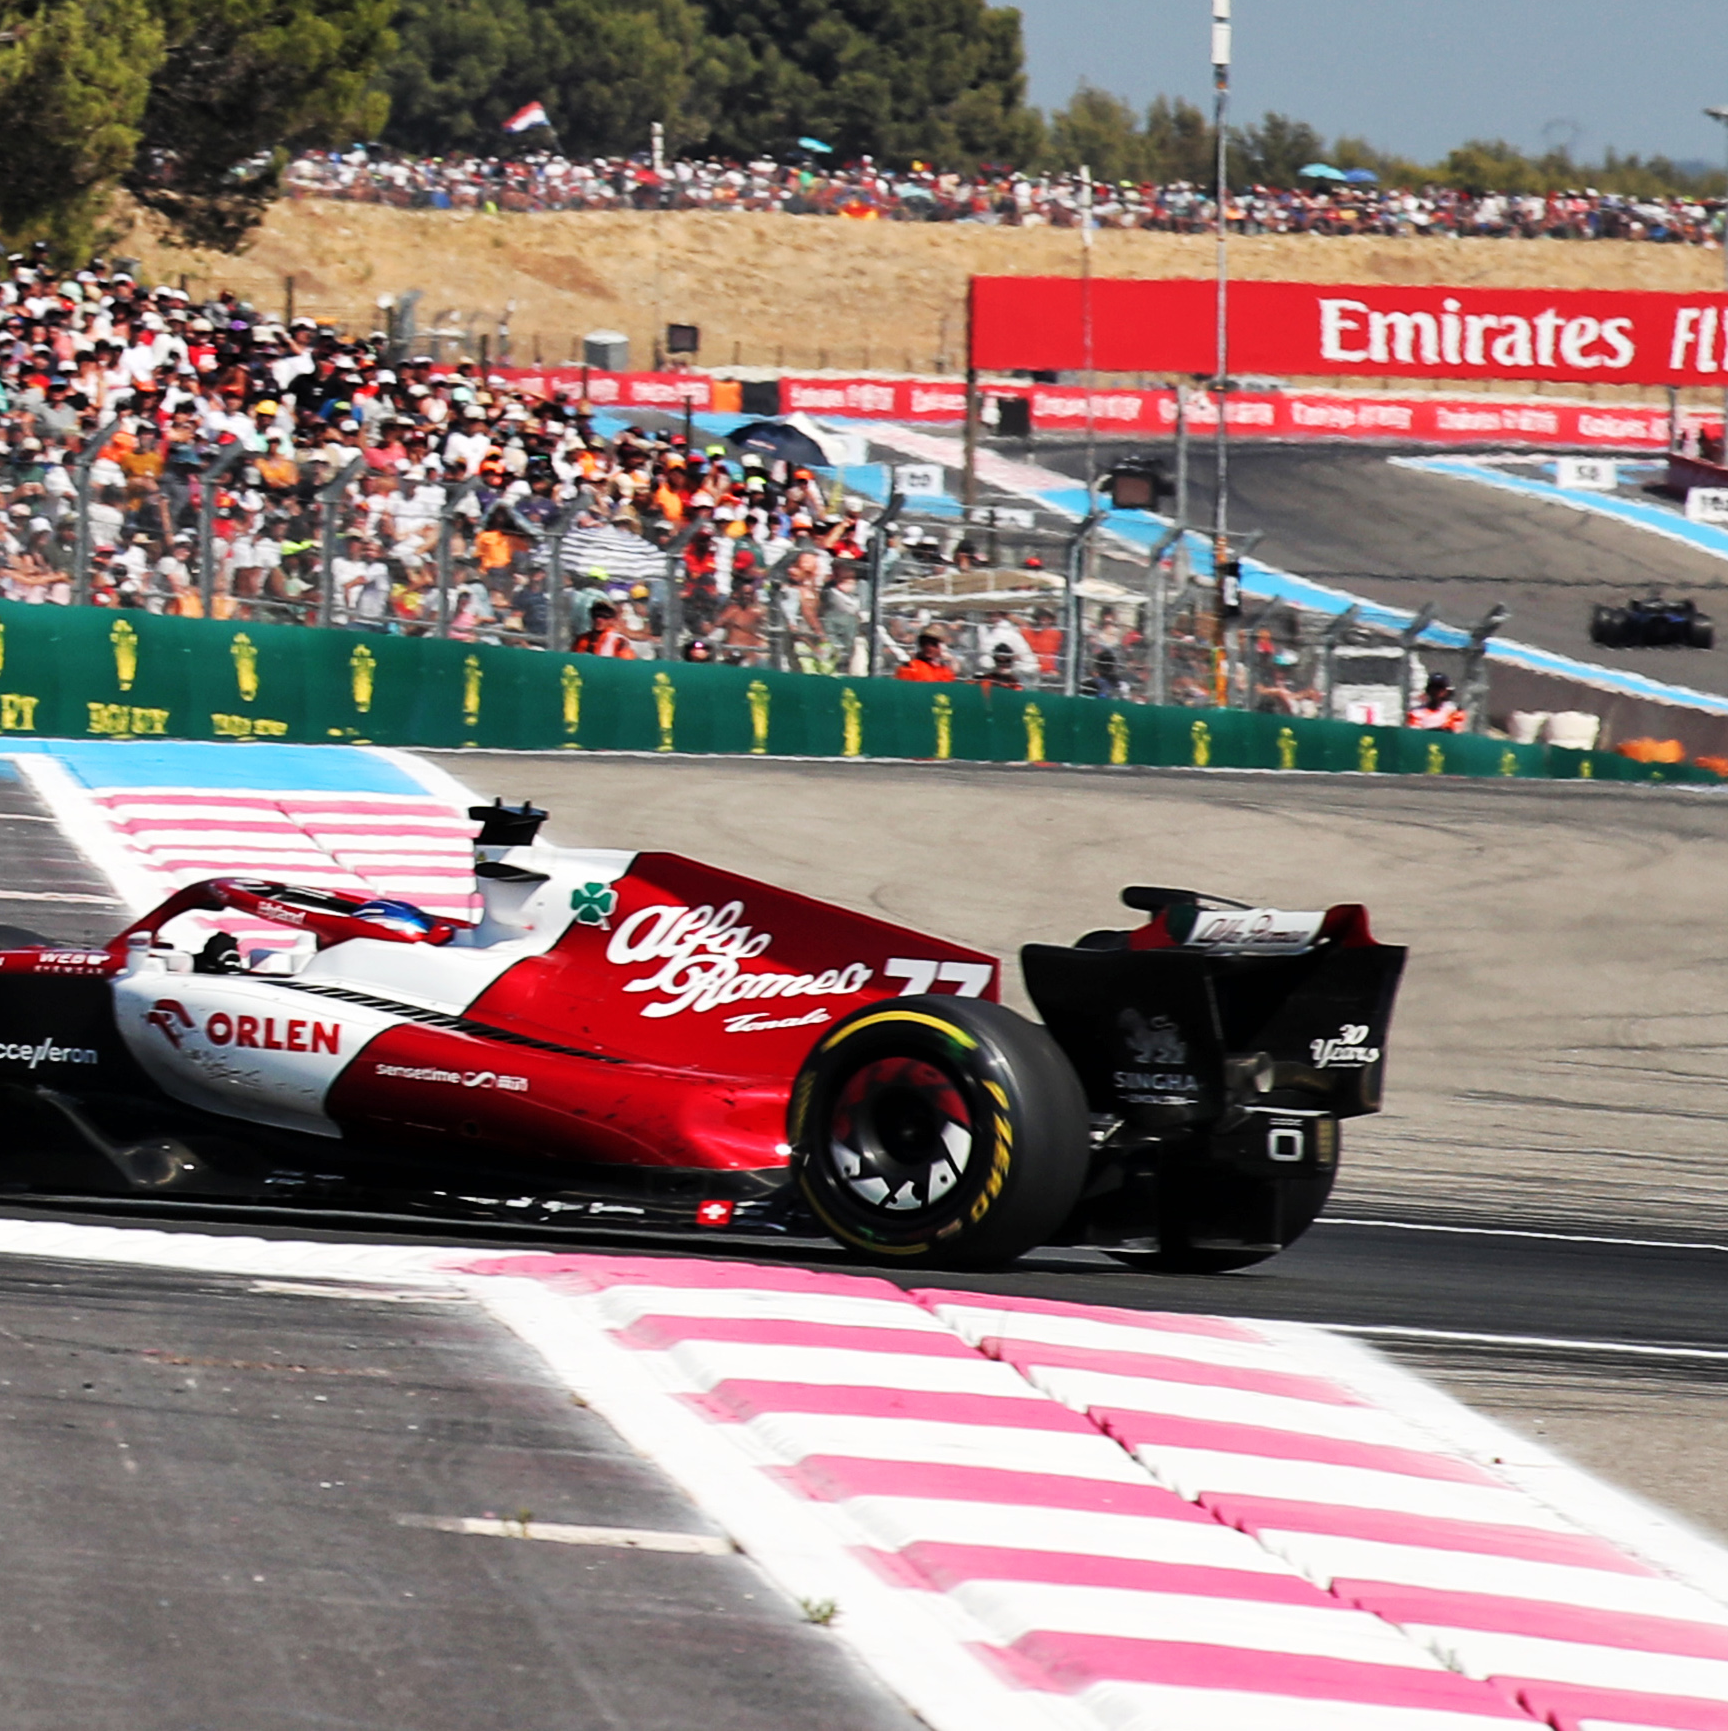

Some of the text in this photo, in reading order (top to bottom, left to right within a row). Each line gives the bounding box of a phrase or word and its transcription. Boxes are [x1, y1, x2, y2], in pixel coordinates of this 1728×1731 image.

[1318, 298, 1728, 373] Emirates FL
[606, 900, 773, 965] Alfa
[622, 954, 875, 1018] Romeo
[884, 957, 993, 999] 77
[205, 1012, 342, 1056] ORLEN
[722, 1007, 833, 1034] Tonale
[1339, 1023, 1370, 1046] 30
[1309, 1038, 1380, 1069] Years
[374, 1063, 462, 1084] sensetime
[1113, 1071, 1199, 1092] SINGHA
